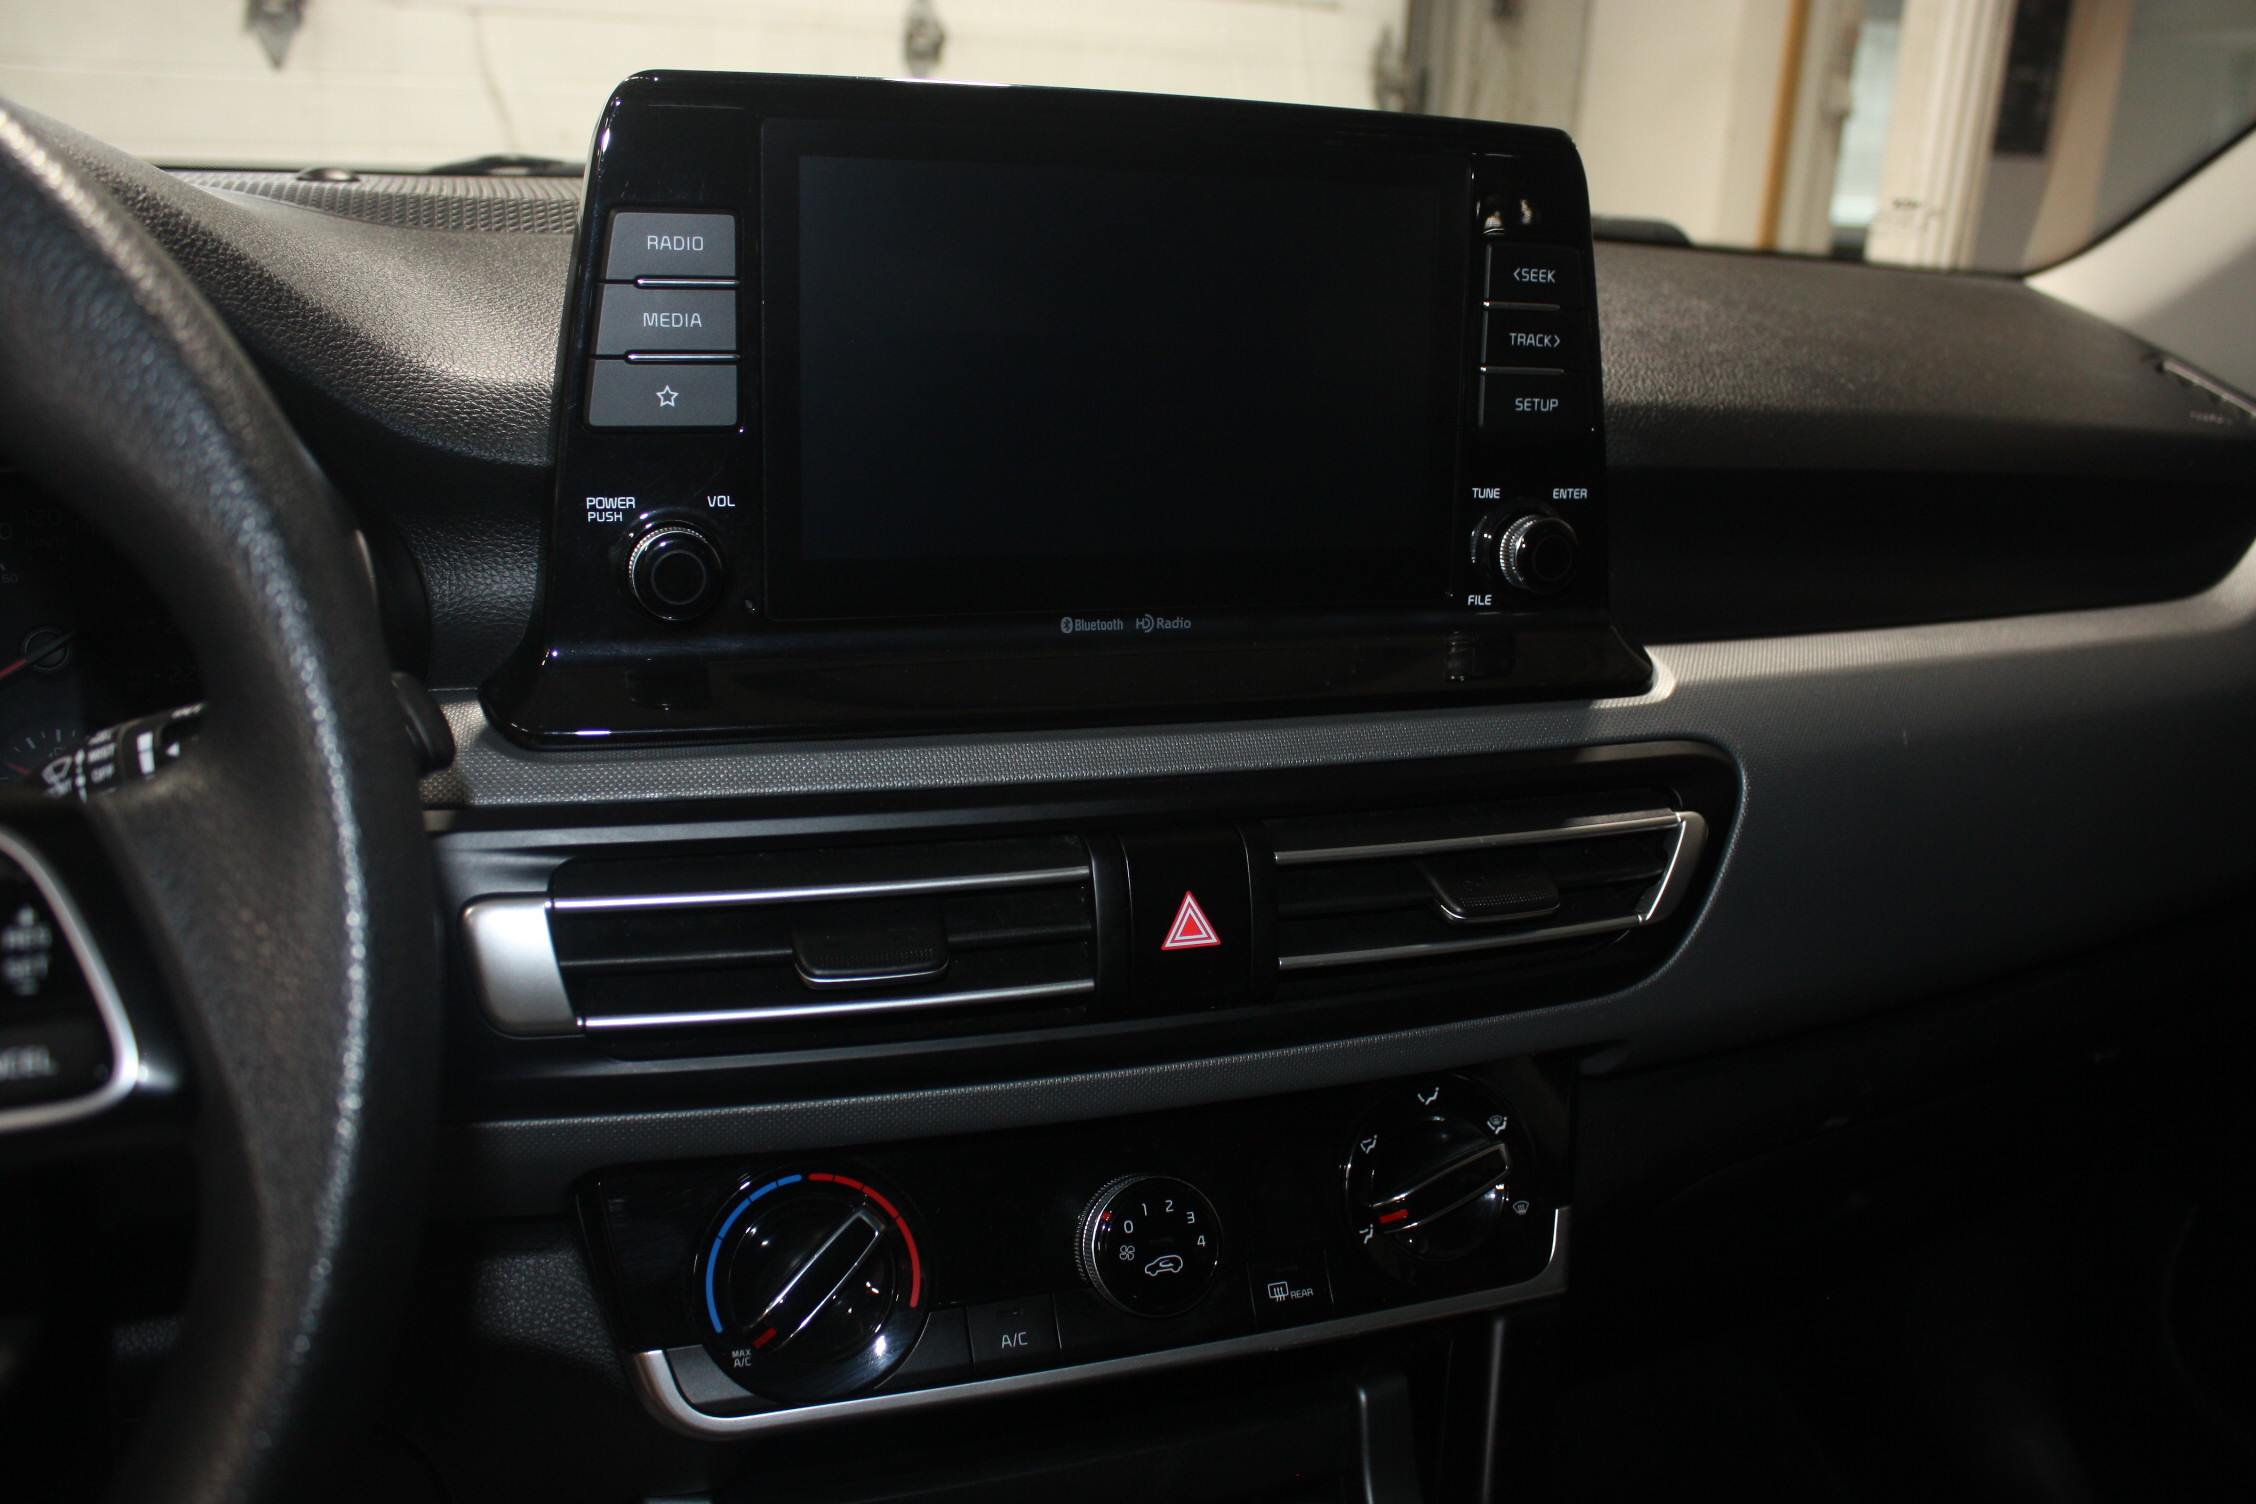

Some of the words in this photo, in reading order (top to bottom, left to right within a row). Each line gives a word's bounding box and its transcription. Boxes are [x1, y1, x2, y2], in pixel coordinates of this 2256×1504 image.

[647, 234, 704, 252] RADIO
[642, 312, 702, 328] MEDIA
[1515, 398, 1559, 412] SETUP
[1472, 487, 1501, 500] TUNE
[1552, 488, 1588, 500] ENTER
[586, 496, 636, 510] POWER
[707, 495, 736, 508] VOL
[587, 511, 623, 523] PUSH
[1467, 594, 1492, 607] FILE
[1074, 618, 1124, 632] Bluetooth
[1135, 613, 1155, 633] HD
[1156, 616, 1192, 630] Radio
[1123, 1219, 1134, 1234] 0
[1140, 1202, 1148, 1216] 1
[1164, 1200, 1174, 1213] 2
[1186, 1211, 1196, 1224] 3
[1196, 1234, 1207, 1247] 4
[1290, 1287, 1314, 1299] REAR
[1000, 1330, 1029, 1349] A/C
[731, 1348, 752, 1359] MAX
[733, 1356, 752, 1368] A/C
